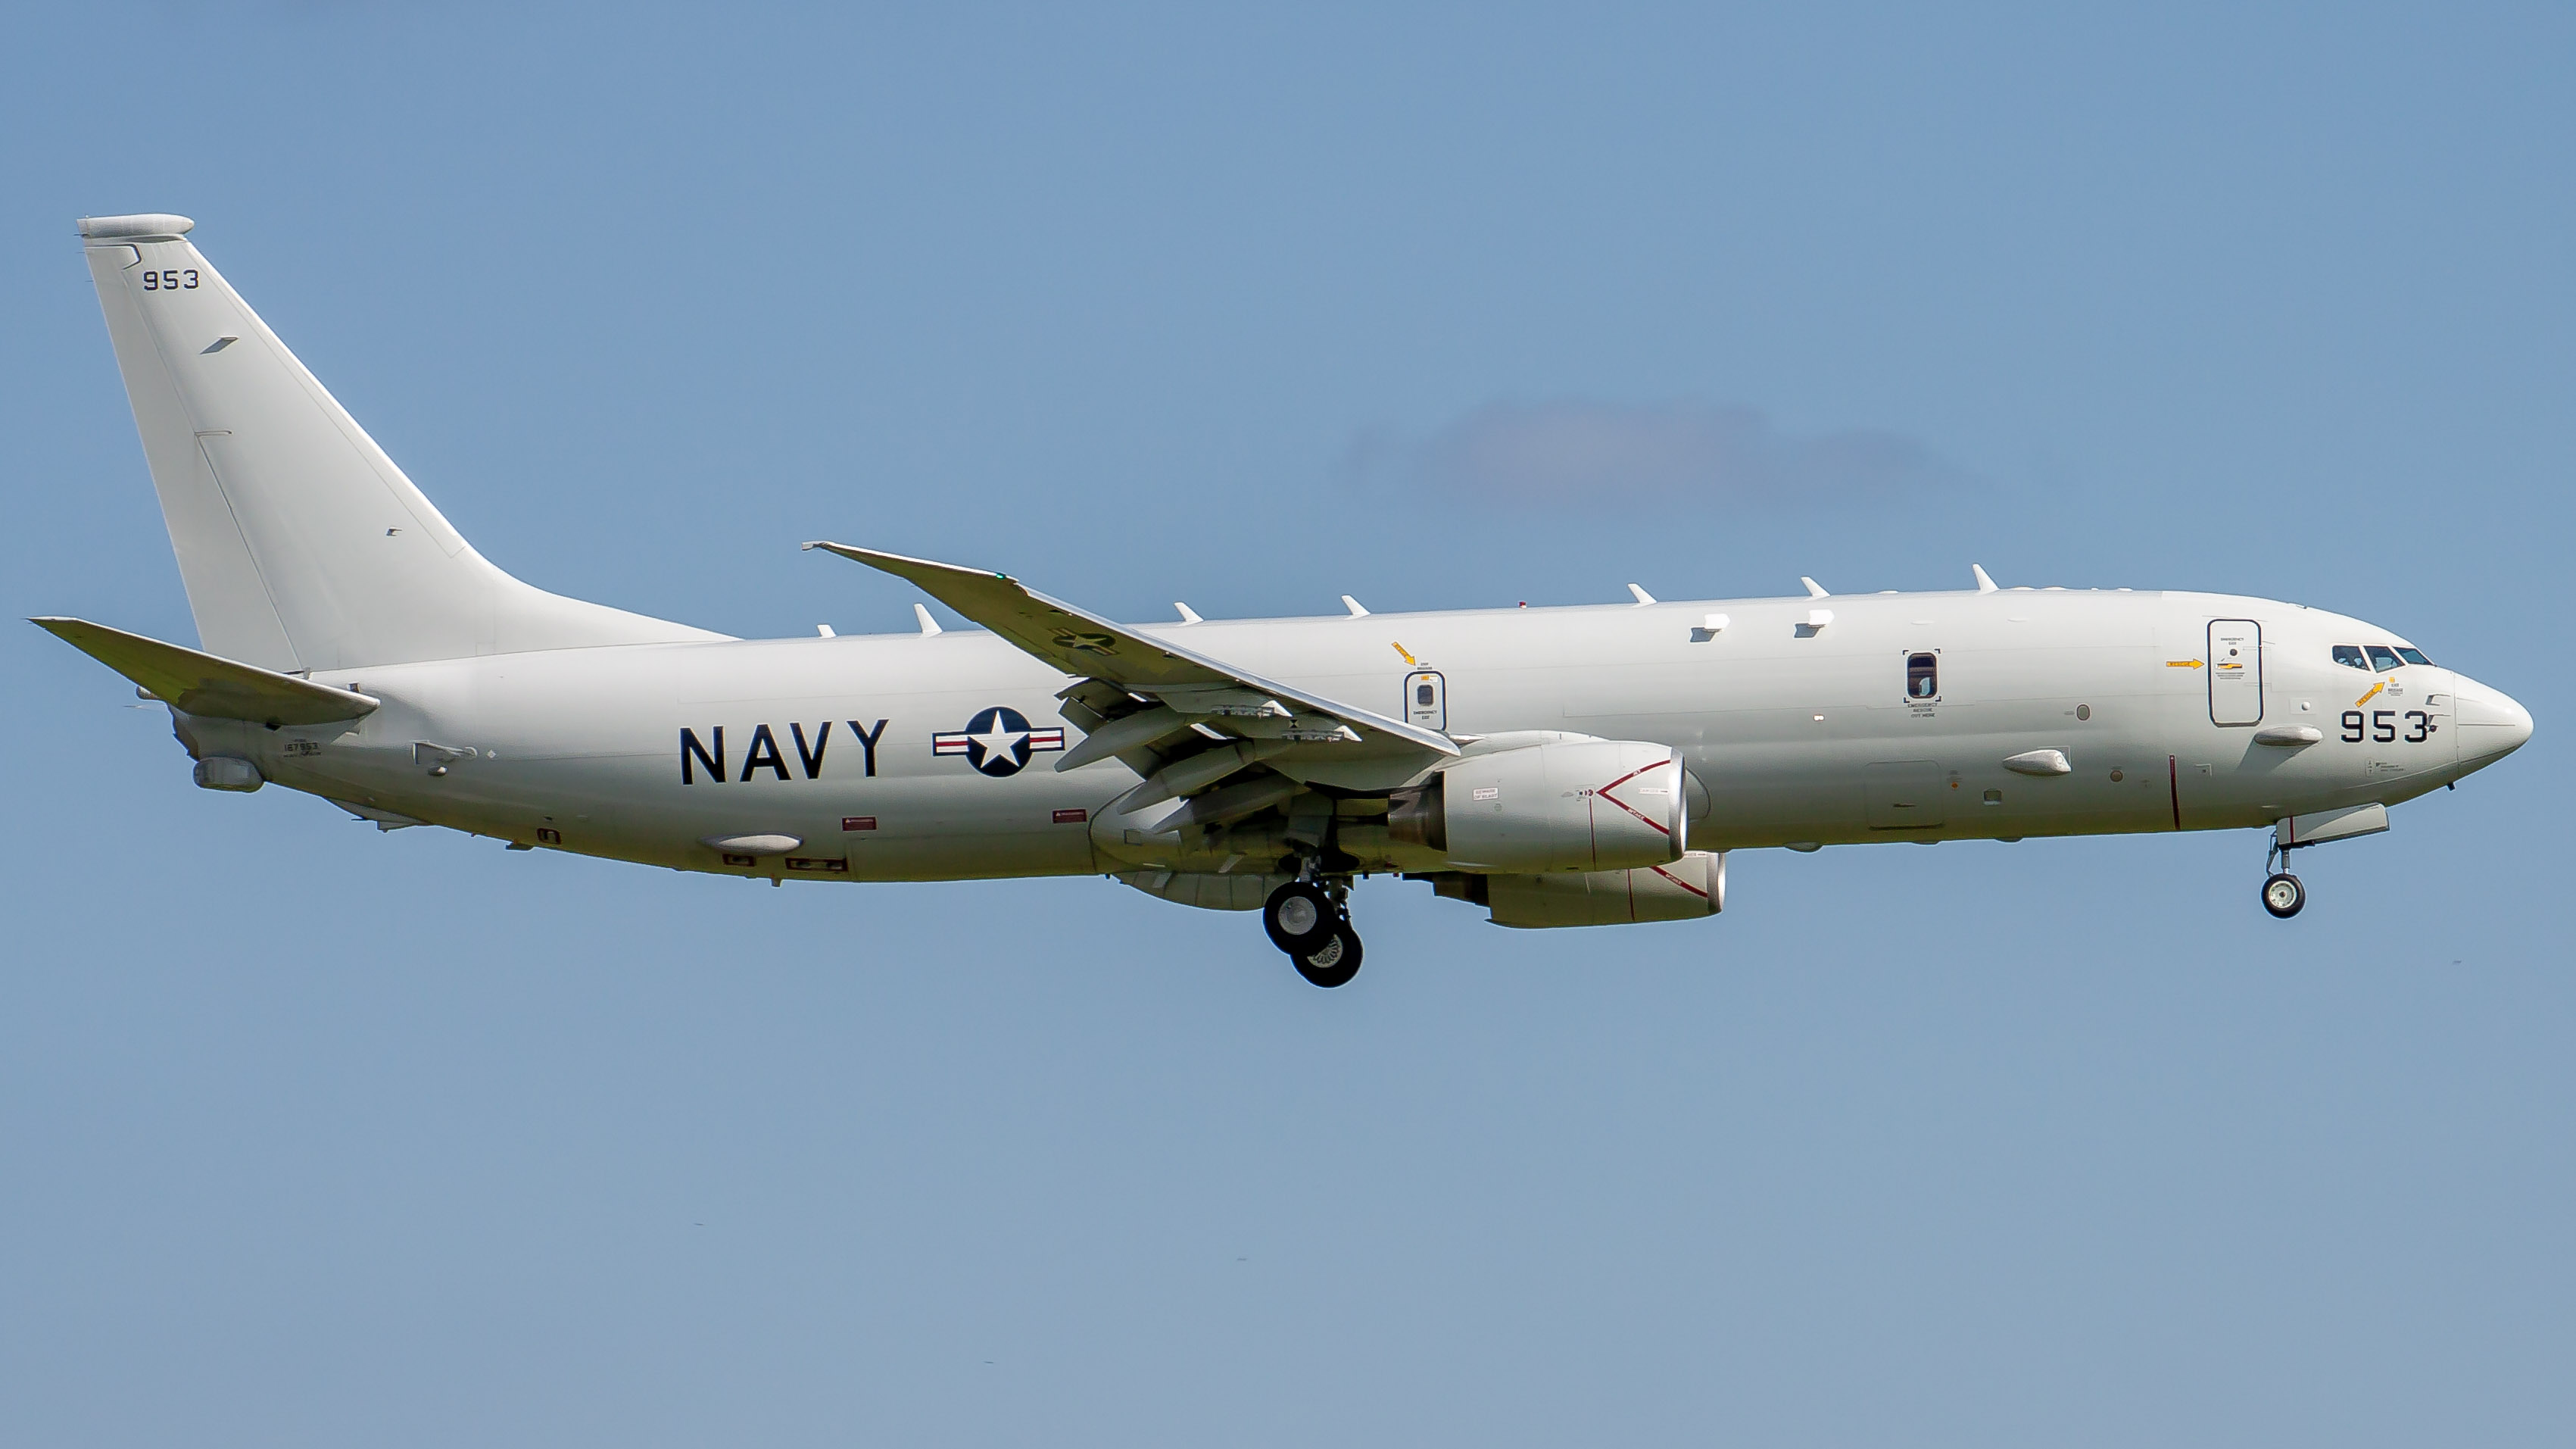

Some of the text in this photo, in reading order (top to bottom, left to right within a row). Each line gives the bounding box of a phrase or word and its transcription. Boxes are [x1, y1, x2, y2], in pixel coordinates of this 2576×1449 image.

[143, 269, 199, 291] 953
[2341, 710, 2428, 743] 953
[680, 719, 889, 785] NAVY
